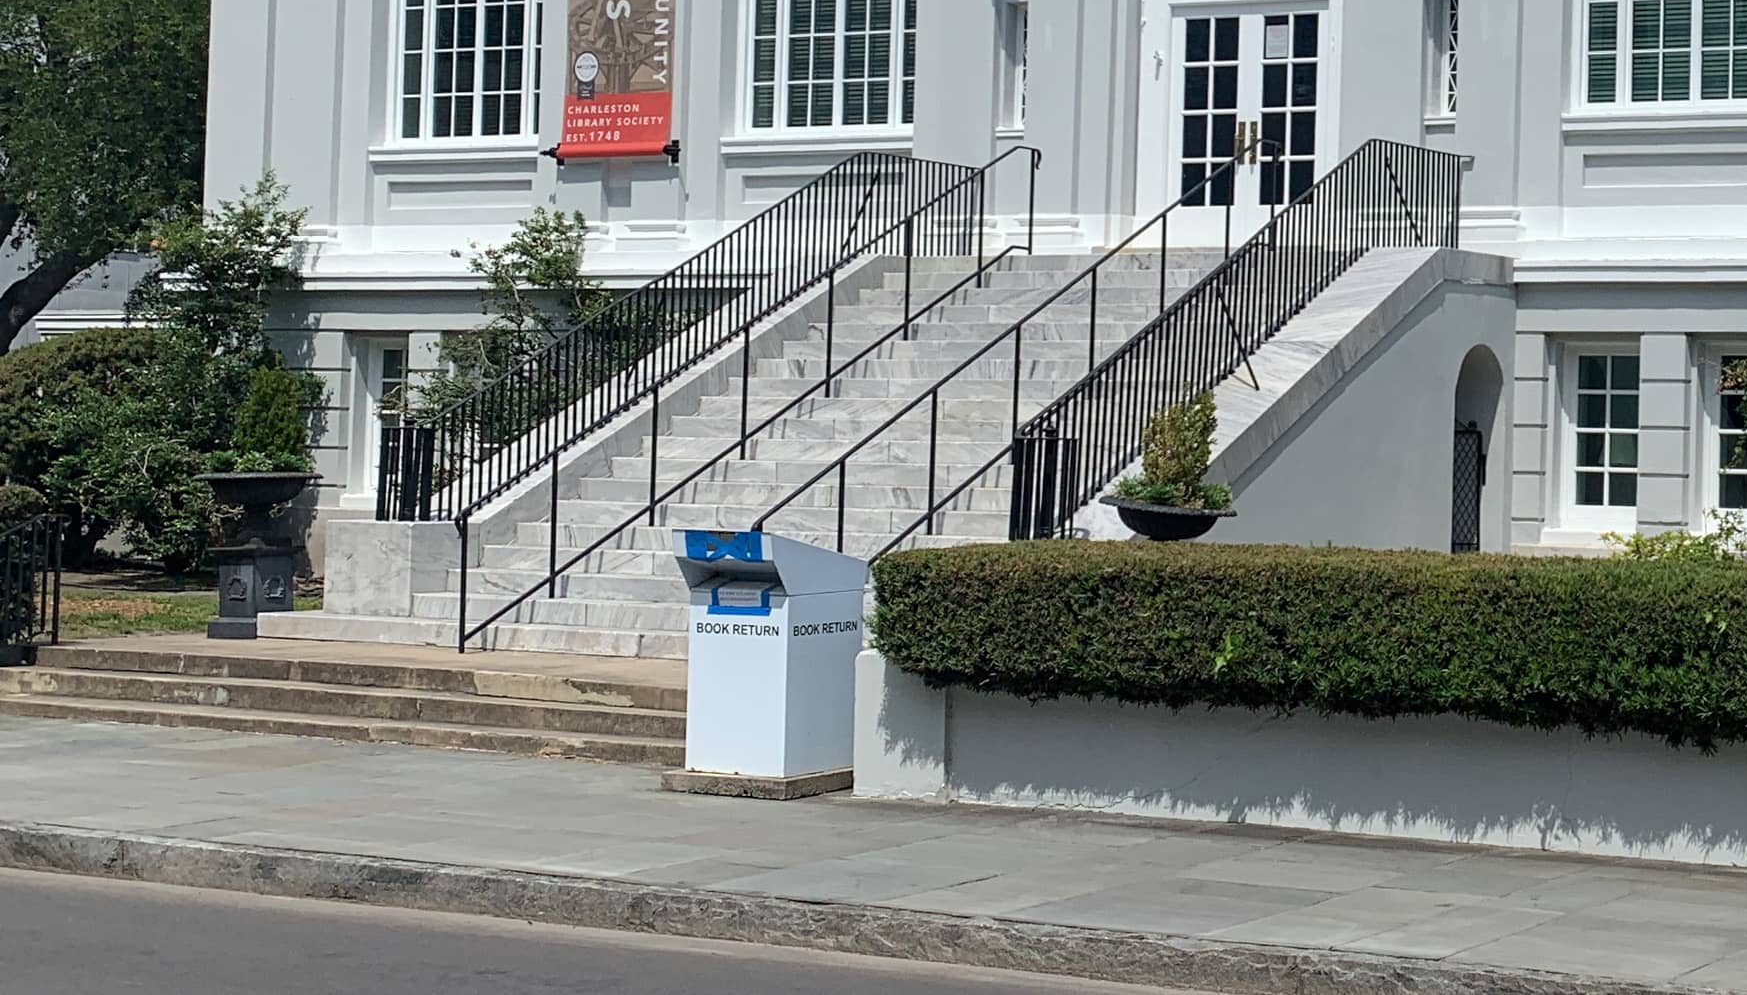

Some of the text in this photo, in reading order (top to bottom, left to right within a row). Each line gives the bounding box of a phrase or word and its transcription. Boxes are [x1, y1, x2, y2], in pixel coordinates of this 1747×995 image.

[567, 104, 640, 115] CHARLESTON
[567, 116, 664, 128] LIBRARY SOCIETY
[696, 622, 780, 637] BOOK RETURN
[793, 620, 858, 637] BOOK RETURN
